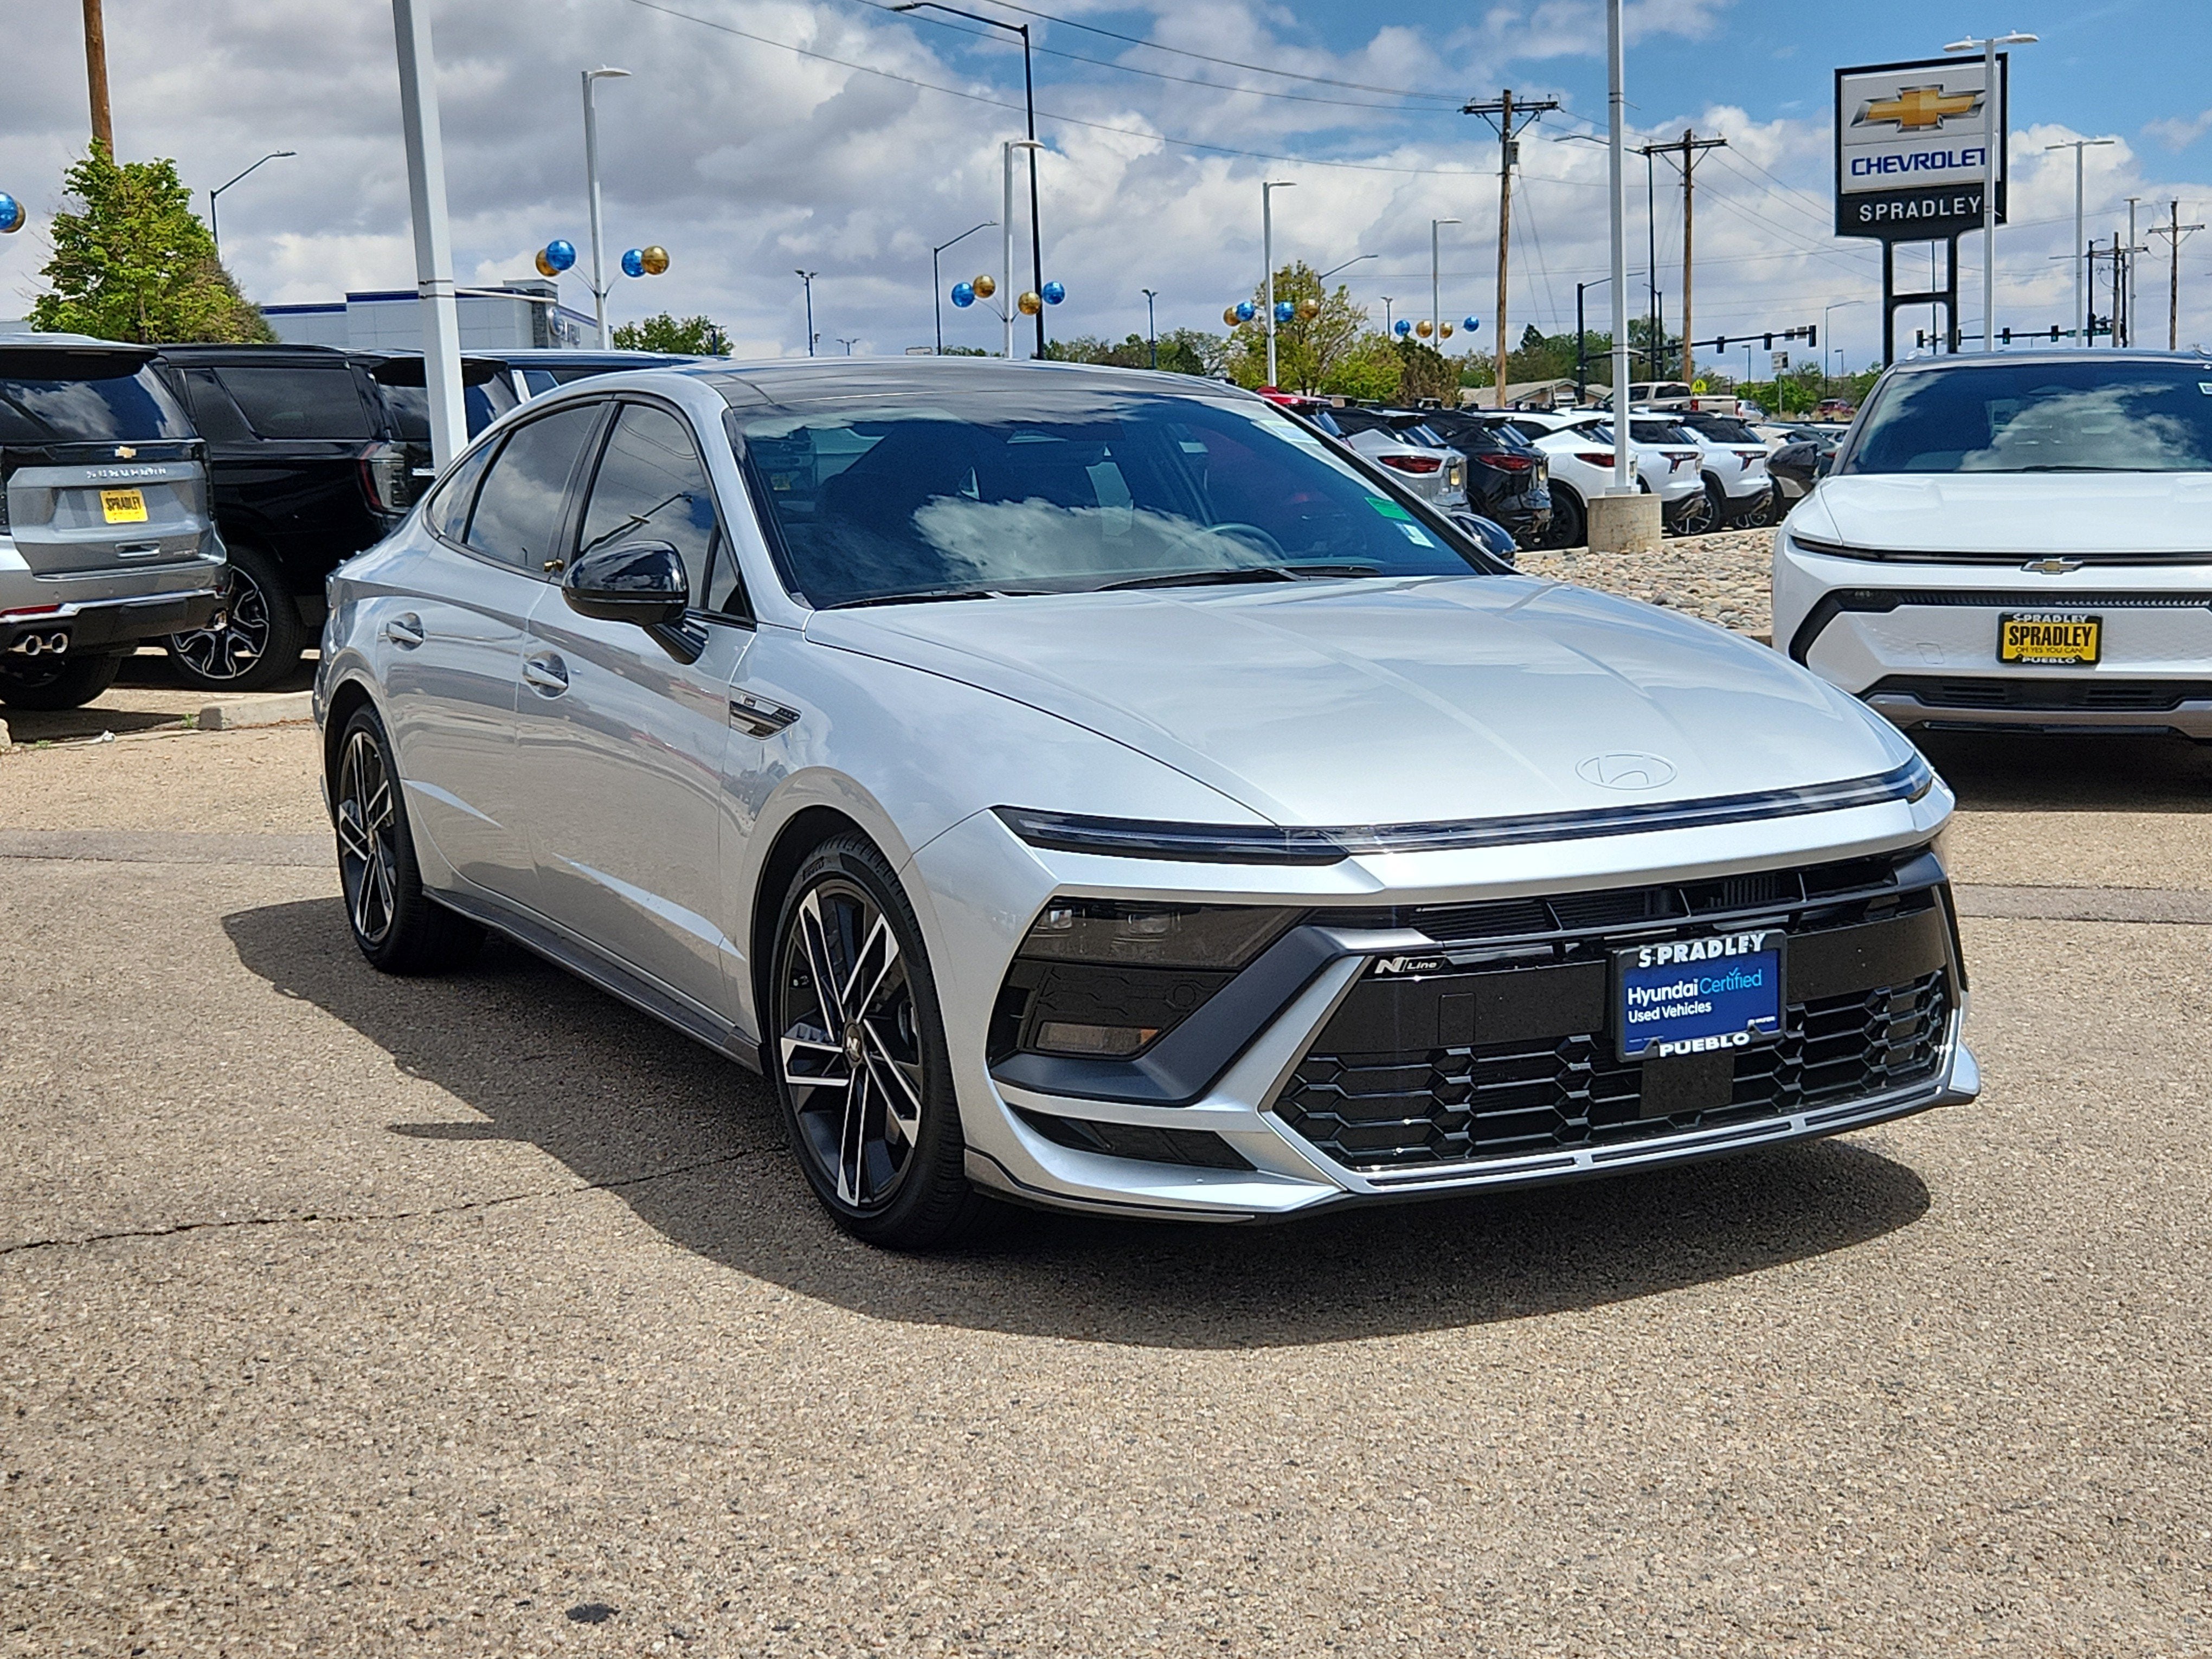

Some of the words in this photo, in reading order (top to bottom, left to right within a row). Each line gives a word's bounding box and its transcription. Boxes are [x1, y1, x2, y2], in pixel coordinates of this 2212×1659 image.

[1851, 147, 1985, 176] CHEVROLET
[1859, 196, 1982, 222] SPRADLEY
[2012, 613, 2088, 623] SPRADLEY
[2008, 625, 2093, 647] SPRADLEY
[1638, 933, 1766, 968] SPRADLEY
[1374, 956, 1405, 974] N
[1407, 961, 1438, 970] Line
[1628, 978, 1699, 1007] Hyundai
[1700, 967, 1763, 994] Certified
[1628, 1006, 1661, 1024] Used
[1661, 1001, 1712, 1019] Vehicles
[1660, 1032, 1751, 1057] PUEBLO
